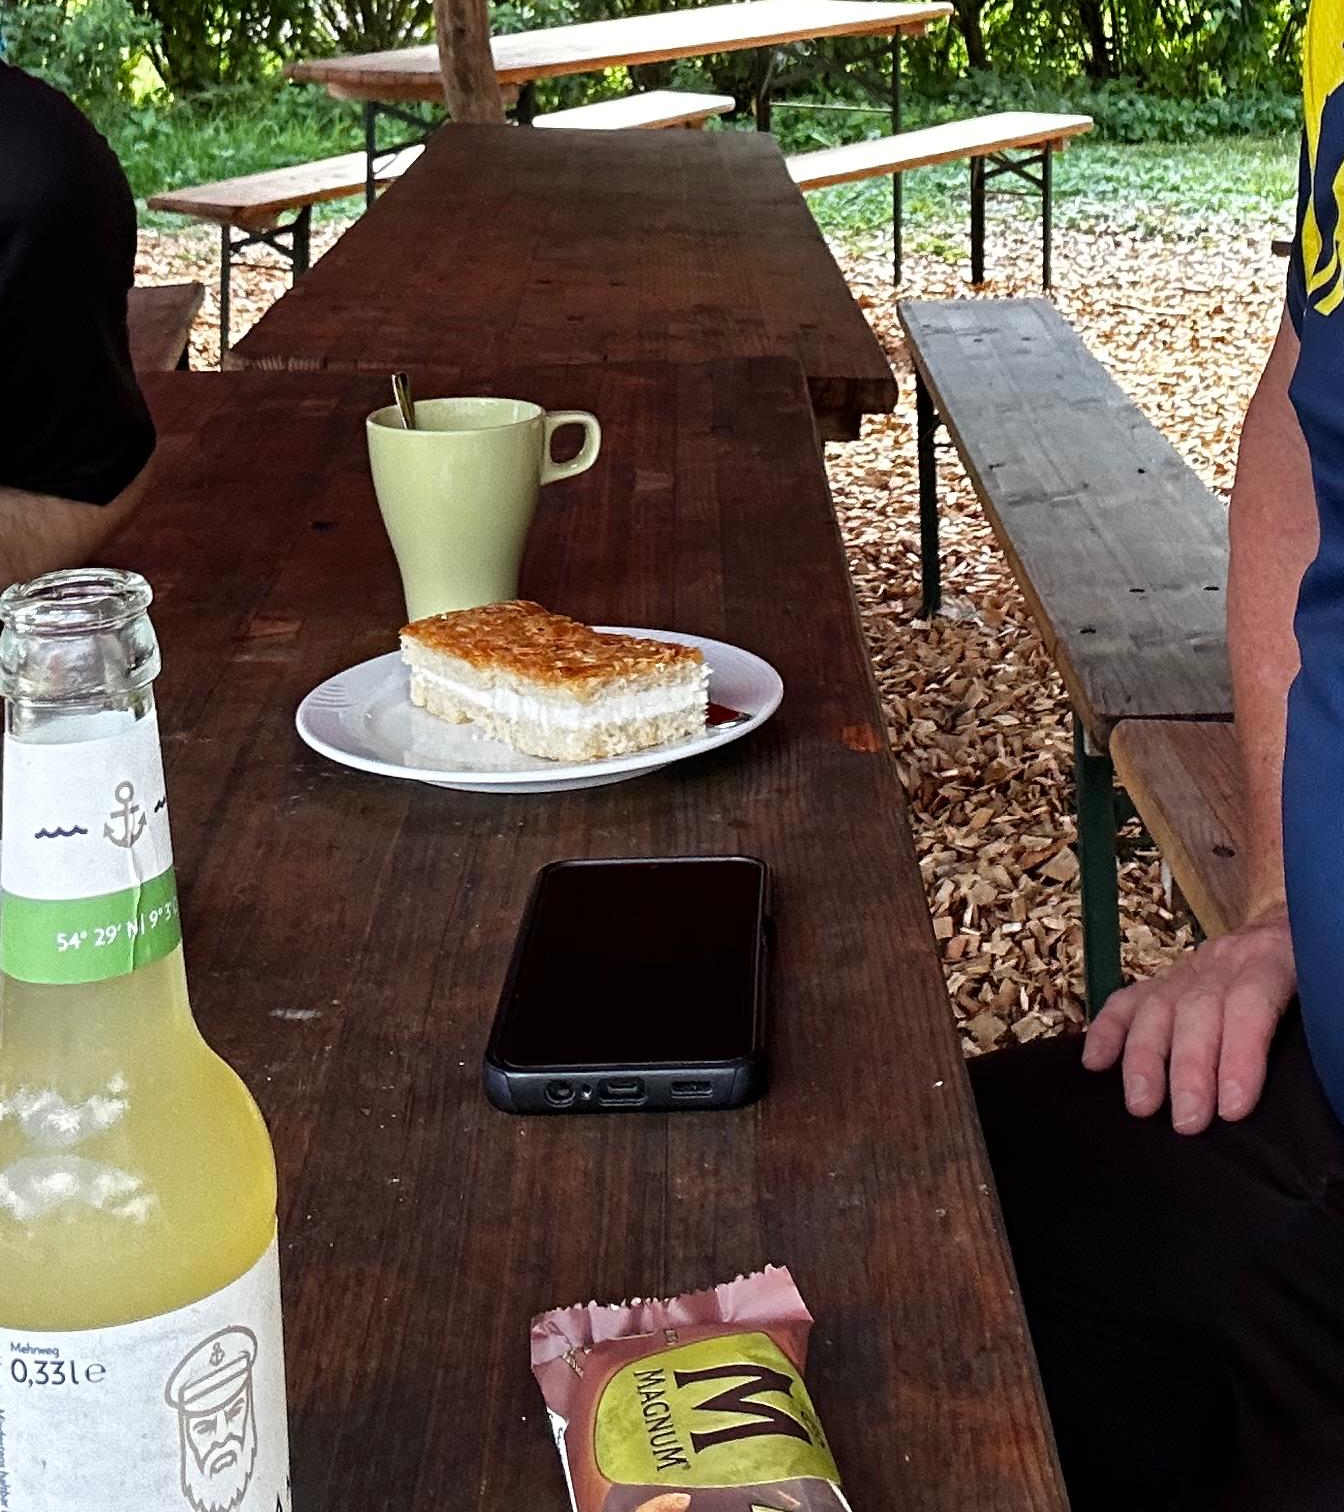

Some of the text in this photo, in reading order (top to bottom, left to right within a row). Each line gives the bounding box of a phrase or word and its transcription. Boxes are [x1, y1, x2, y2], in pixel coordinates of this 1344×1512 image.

[56, 930, 88, 952] 54°
[10, 1341, 60, 1358] Mehrweg
[633, 1368, 688, 1471] MAGNUM
